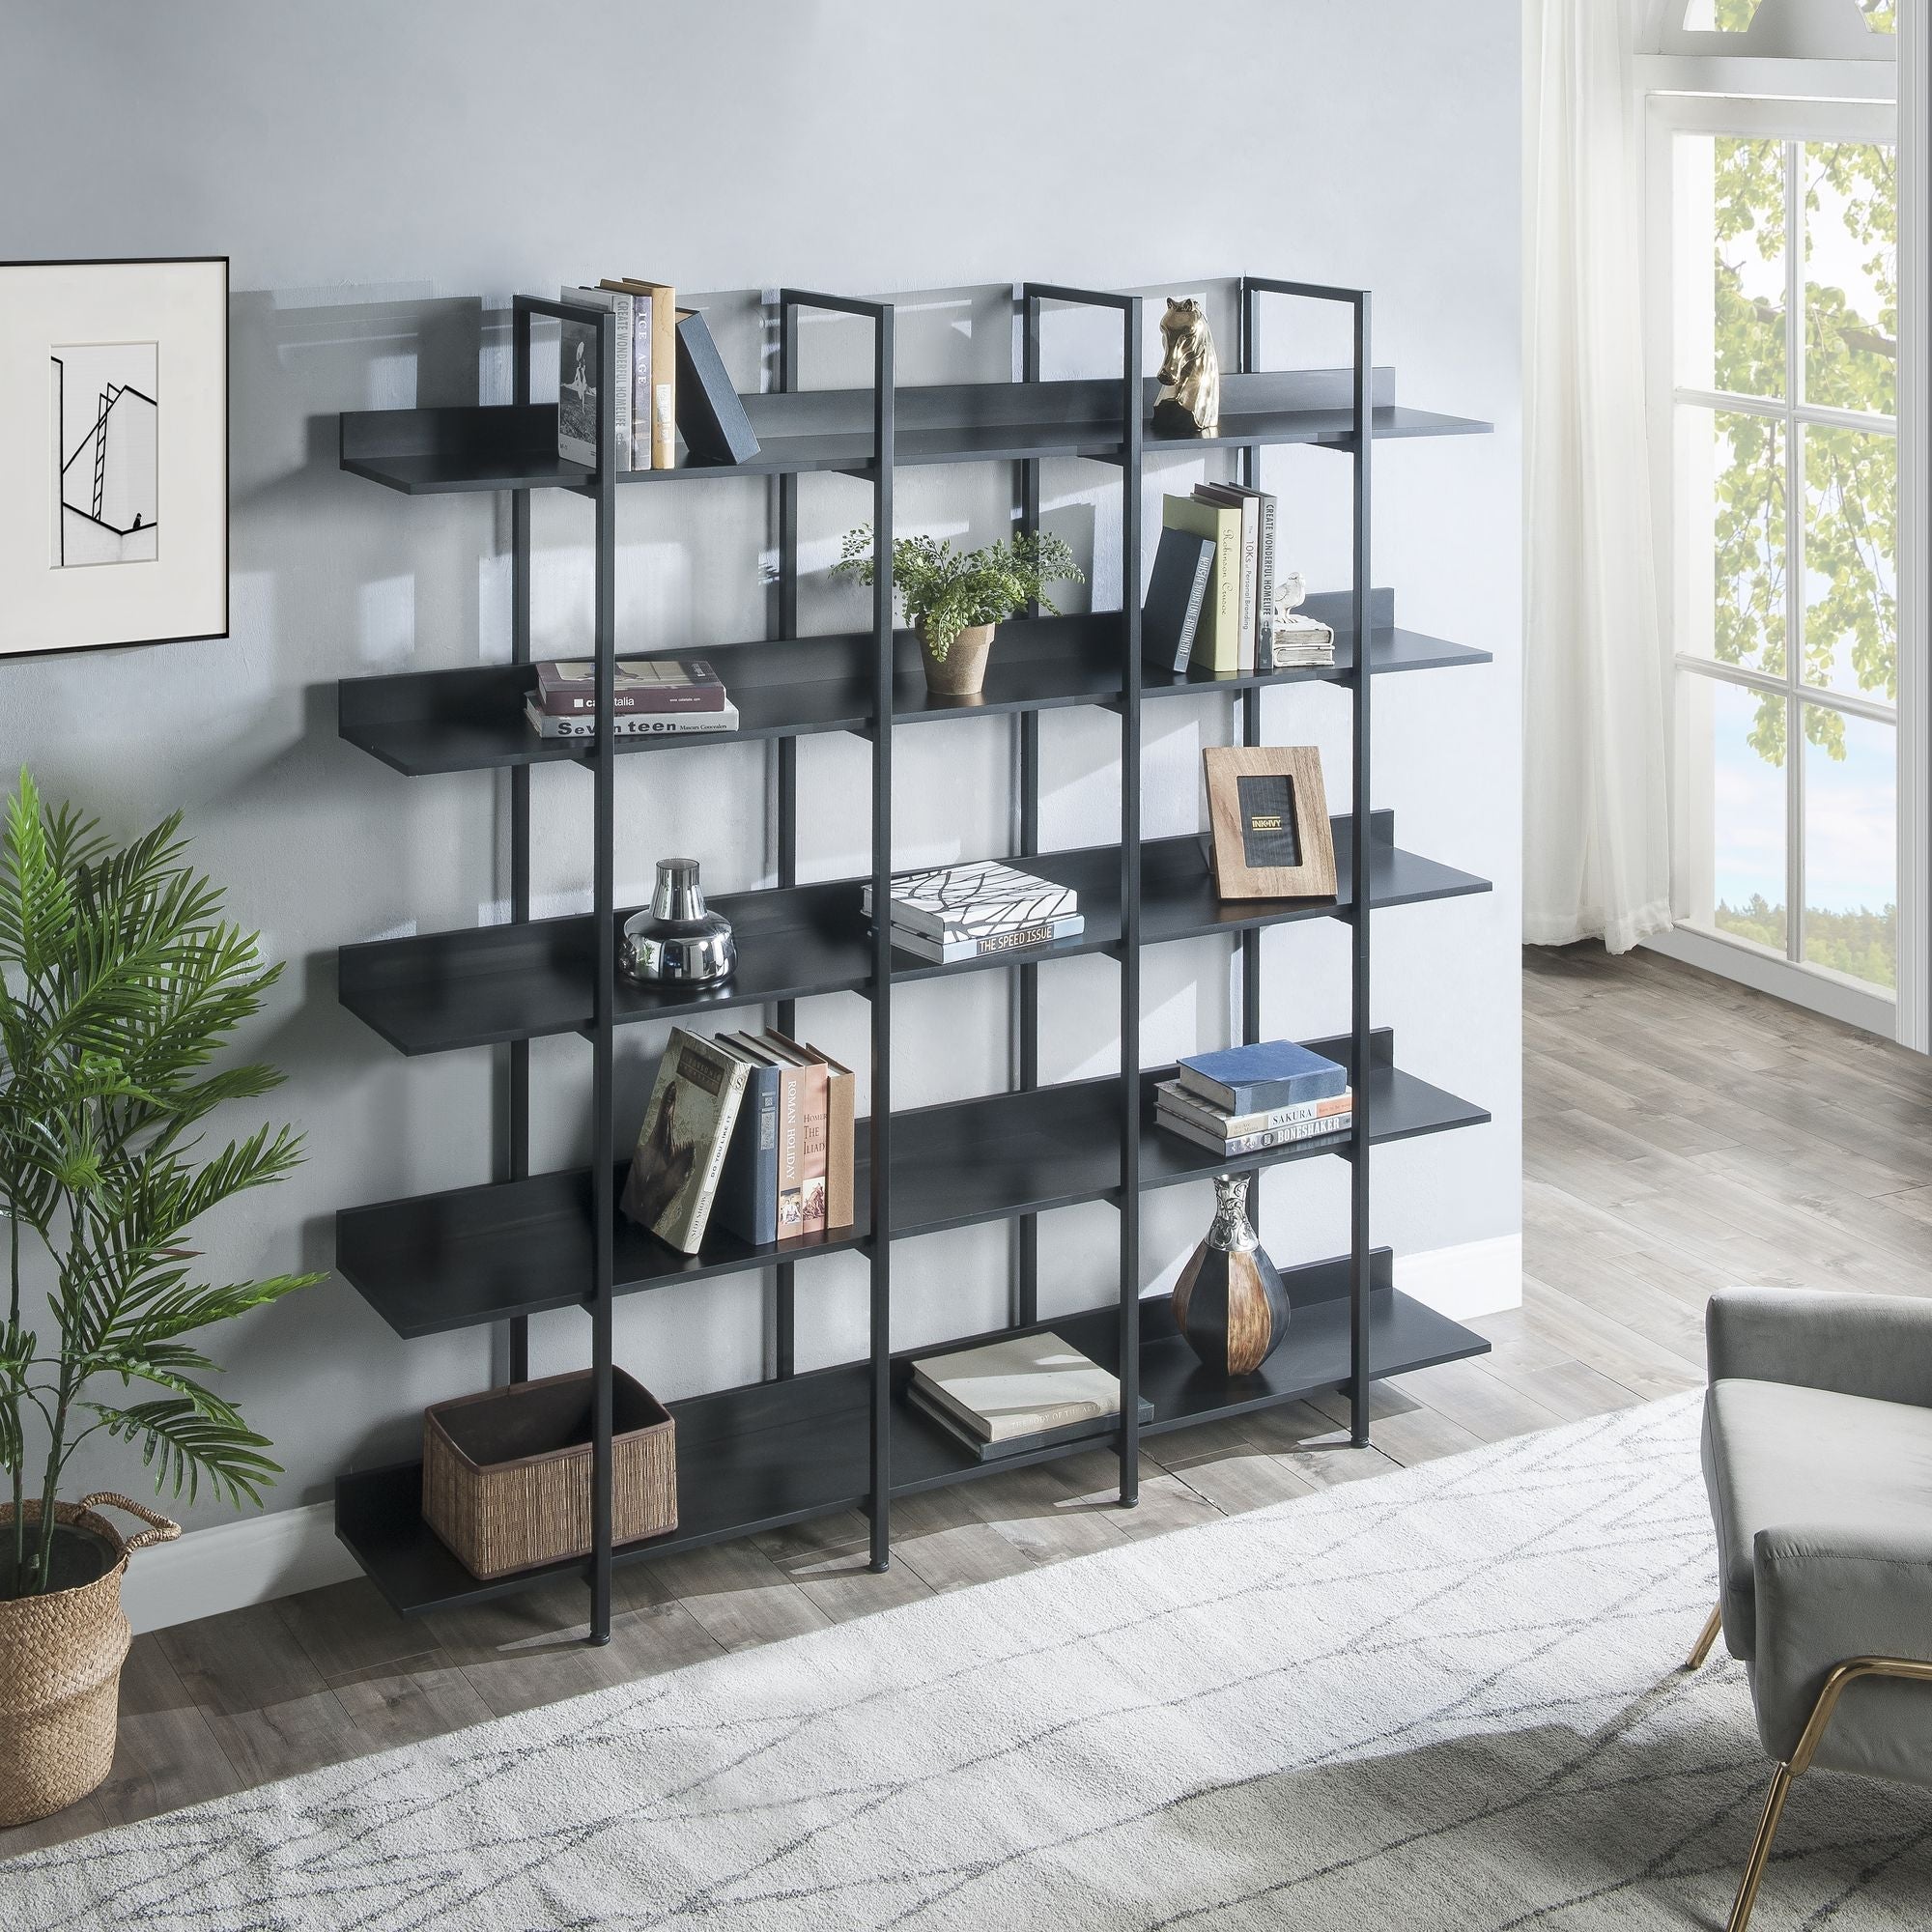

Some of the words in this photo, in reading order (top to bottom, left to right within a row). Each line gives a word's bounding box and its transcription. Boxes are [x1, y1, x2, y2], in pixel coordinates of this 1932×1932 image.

[618, 300, 629, 331] CREATE
[638, 313, 647, 340] ICE
[616, 333, 629, 384] WONDERFUL
[638, 353, 647, 384] AGE
[616, 387, 627, 427] HOMELIFE
[1265, 504, 1275, 530] CREATE
[1264, 532, 1274, 578] WONDERFUL
[1263, 580, 1272, 615] HOMELIFE
[557, 722, 622, 735] Sevn
[980, 940, 997, 952] THE
[998, 932, 1025, 949] SPEED
[1027, 926, 1053, 943] ISSUE
[787, 1080, 797, 1123] ROMAN
[1271, 1107, 1313, 1126] SAKURA
[1277, 1117, 1340, 1142] BONESHAKER
[715, 1144, 724, 1163] YOU
[786, 1128, 797, 1180] HOLIDAY
